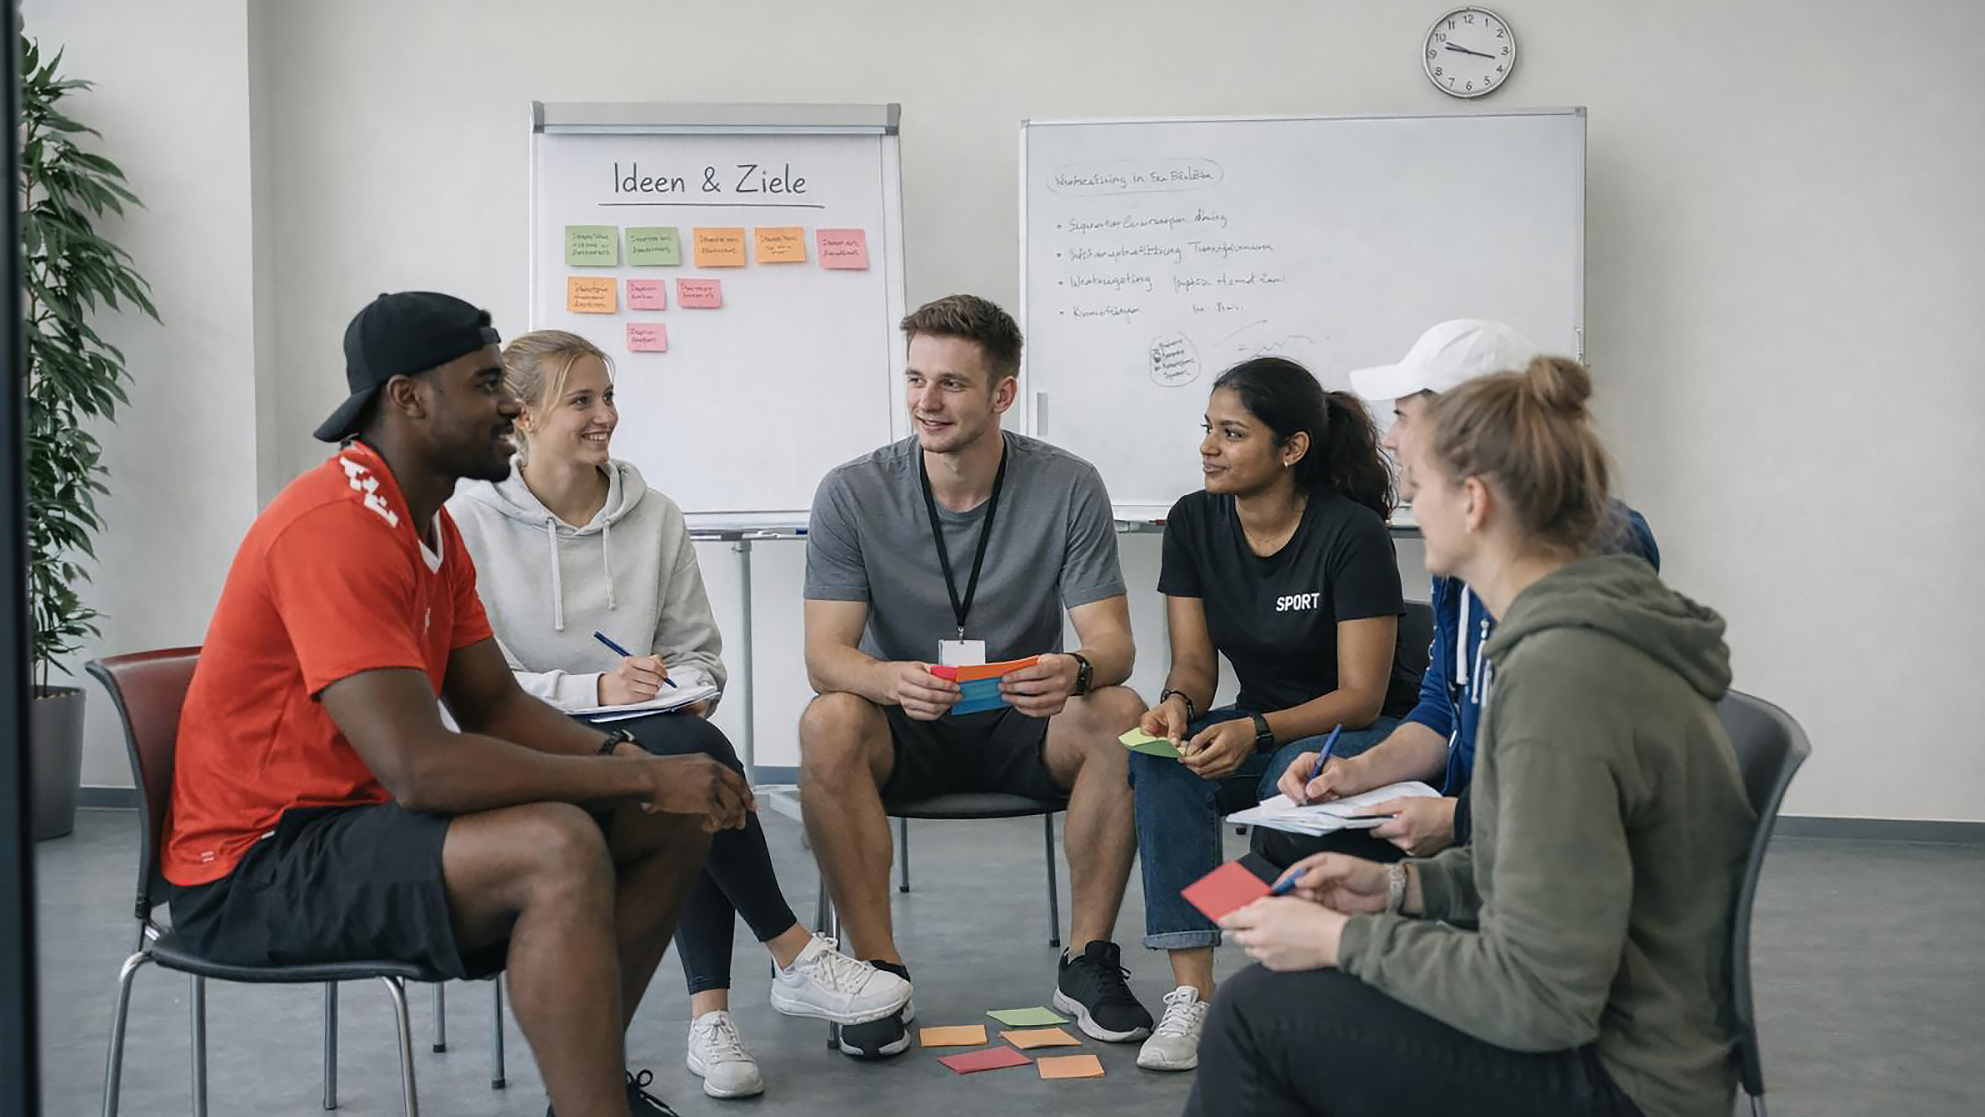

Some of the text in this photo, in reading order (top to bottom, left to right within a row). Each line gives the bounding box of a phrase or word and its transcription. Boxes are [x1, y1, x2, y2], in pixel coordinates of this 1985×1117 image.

[1463, 14, 1474, 25] 12
[1447, 20, 1455, 30] 11
[1435, 33, 1447, 42] 10
[1496, 28, 1504, 38] 2
[1429, 49, 1437, 59] 9
[1501, 46, 1509, 56] 3
[1435, 66, 1443, 76] 8
[1496, 65, 1504, 73] 4
[1448, 77, 1455, 87] 7
[1466, 81, 1473, 91] 6
[1485, 76, 1491, 86] 5
[613, 162, 807, 194] Ideen & Ziele
[1276, 593, 1320, 611] SPORT
